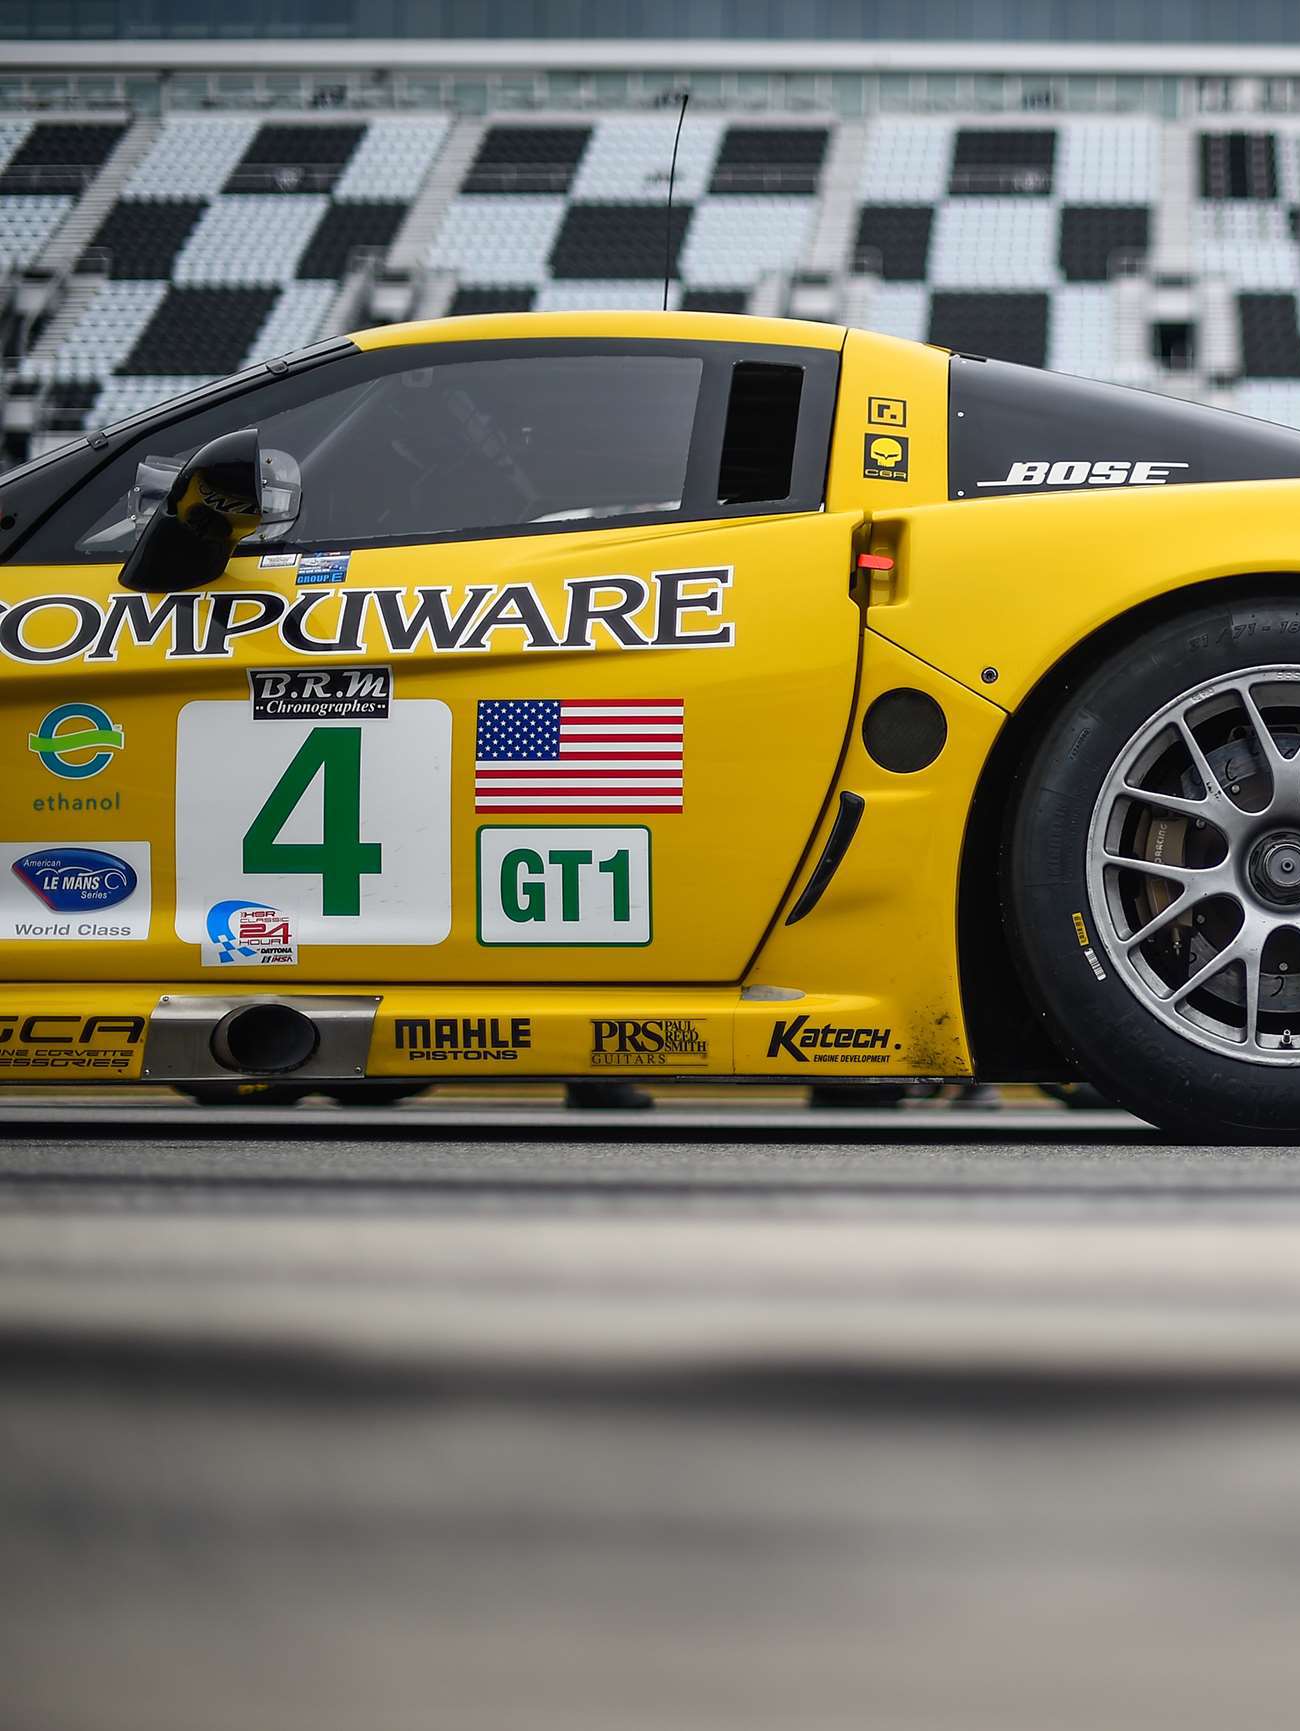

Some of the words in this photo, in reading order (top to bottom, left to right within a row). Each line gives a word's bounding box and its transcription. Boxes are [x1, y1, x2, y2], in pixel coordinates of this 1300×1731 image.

[977, 461, 1189, 487] BOSE
[297, 574, 330, 584] GROUP
[331, 572, 343, 583] E
[0, 565, 735, 665] OMPUWARE
[266, 700, 376, 717] Chronographes
[32, 791, 121, 811] ethanol
[242, 726, 383, 917] 4
[23, 858, 61, 868] American
[43, 876, 60, 890] LE
[62, 876, 101, 890] MANS
[500, 847, 631, 924] GT1
[80, 890, 108, 900] Series
[243, 910, 276, 918] HSR
[15, 923, 71, 937] World
[77, 923, 132, 937] Class
[240, 922, 292, 945] 24
[239, 938, 281, 946] HOUR
[665, 1020, 697, 1032] PAUL
[394, 1017, 532, 1049] MAHLE
[591, 1020, 665, 1053] PRS
[664, 1031, 700, 1042] REED
[664, 1041, 707, 1052] SMITH
[34, 1049, 135, 1057] CORVETTE
[408, 1049, 519, 1061] PISTONS
[591, 1053, 667, 1065] GUITARS
[812, 1054, 839, 1063] ENGINE
[840, 1054, 890, 1063] DEVELOPMENT
